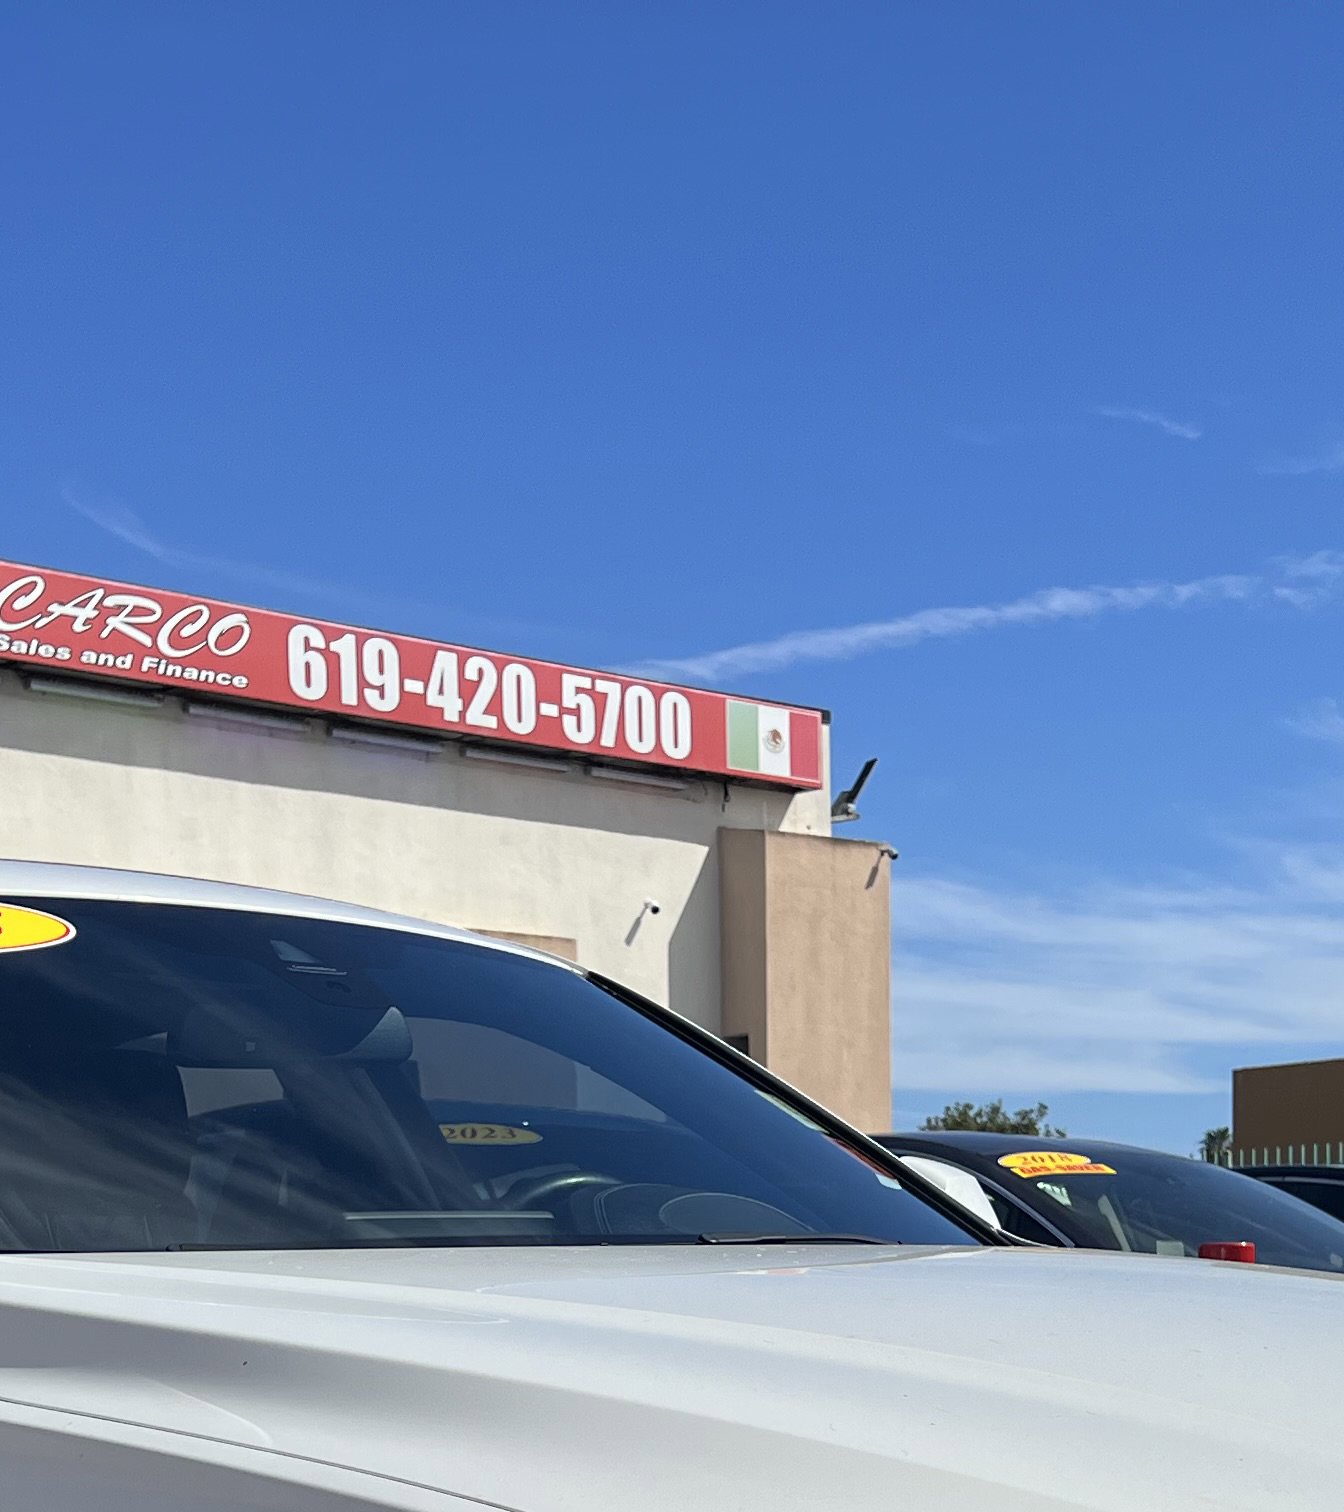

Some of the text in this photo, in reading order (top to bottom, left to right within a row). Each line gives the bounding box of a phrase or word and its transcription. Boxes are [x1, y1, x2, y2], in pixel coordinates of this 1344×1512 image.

[80, 648, 133, 670] and
[141, 656, 251, 690] Finance
[286, 623, 693, 760] 619-420-5700
[443, 1126, 518, 1140] 2023
